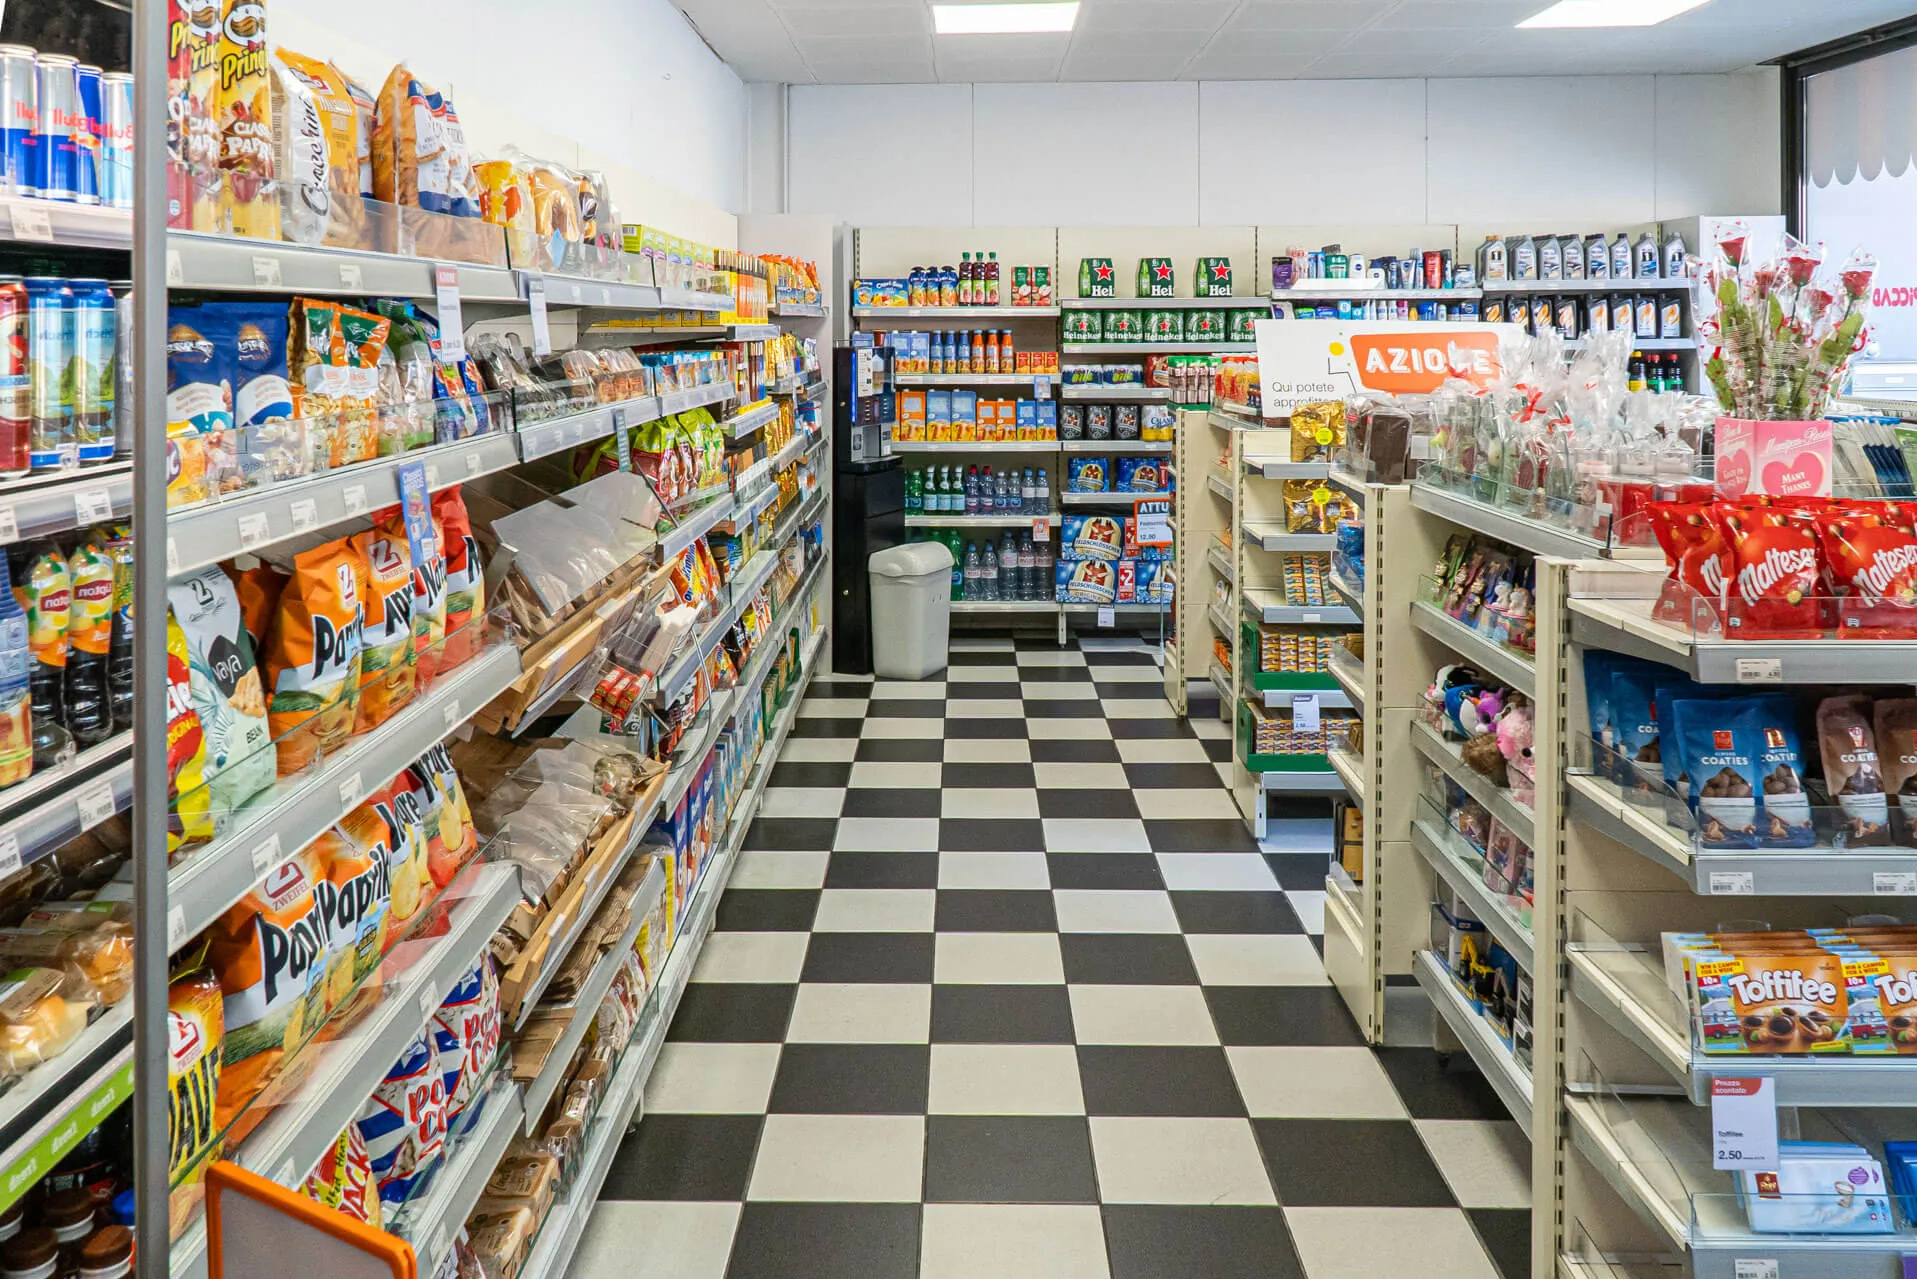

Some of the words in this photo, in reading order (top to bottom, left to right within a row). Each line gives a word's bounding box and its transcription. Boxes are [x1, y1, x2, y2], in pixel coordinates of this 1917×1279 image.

[1365, 347, 1493, 374] AZIOE
[1272, 381, 1292, 392] Qui
[1296, 383, 1335, 394] potete
[212, 653, 242, 684] vaya
[1701, 756, 1749, 766] COATIES
[1728, 969, 1837, 1004] Toffifee
[1718, 1150, 1742, 1160] 2.50
